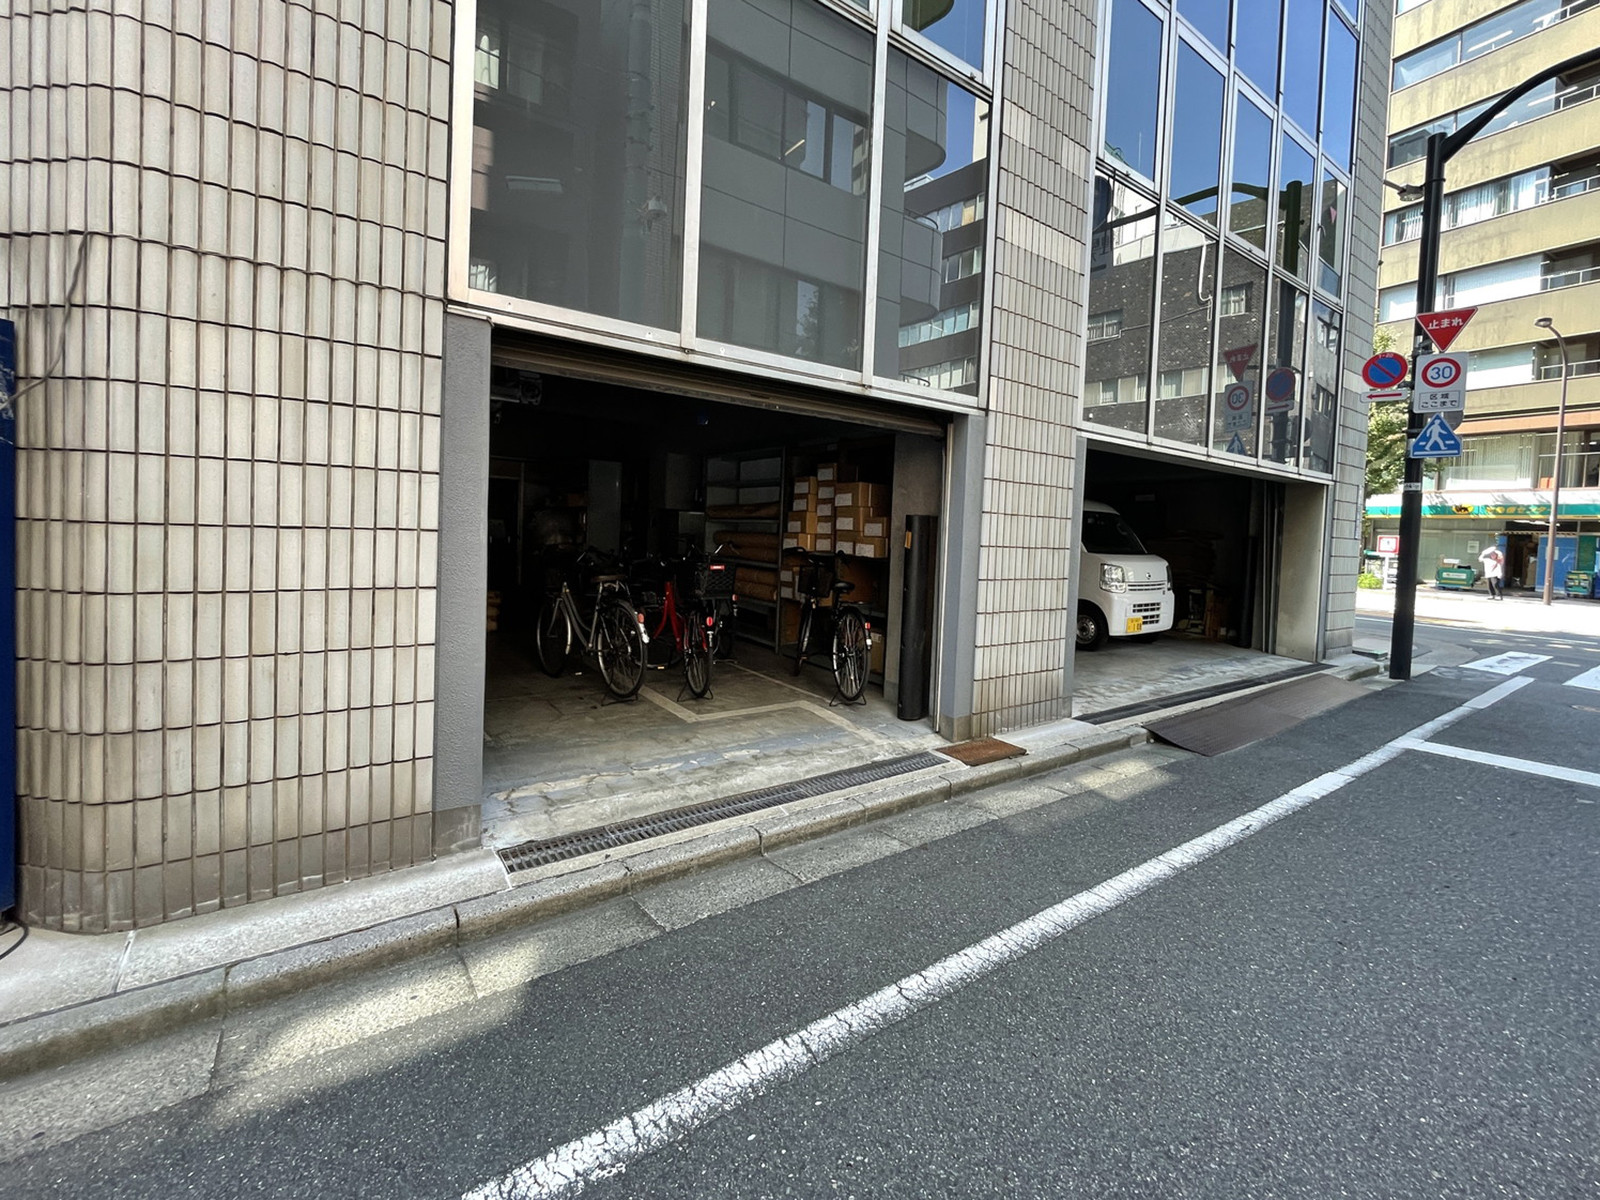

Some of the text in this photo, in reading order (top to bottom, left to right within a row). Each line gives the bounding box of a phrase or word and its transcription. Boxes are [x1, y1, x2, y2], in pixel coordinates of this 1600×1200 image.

[1427, 317, 1464, 329] 止まれ
[1430, 366, 1453, 380] 30
[1429, 393, 1449, 401] 区域
[1421, 400, 1458, 408] ここまで
